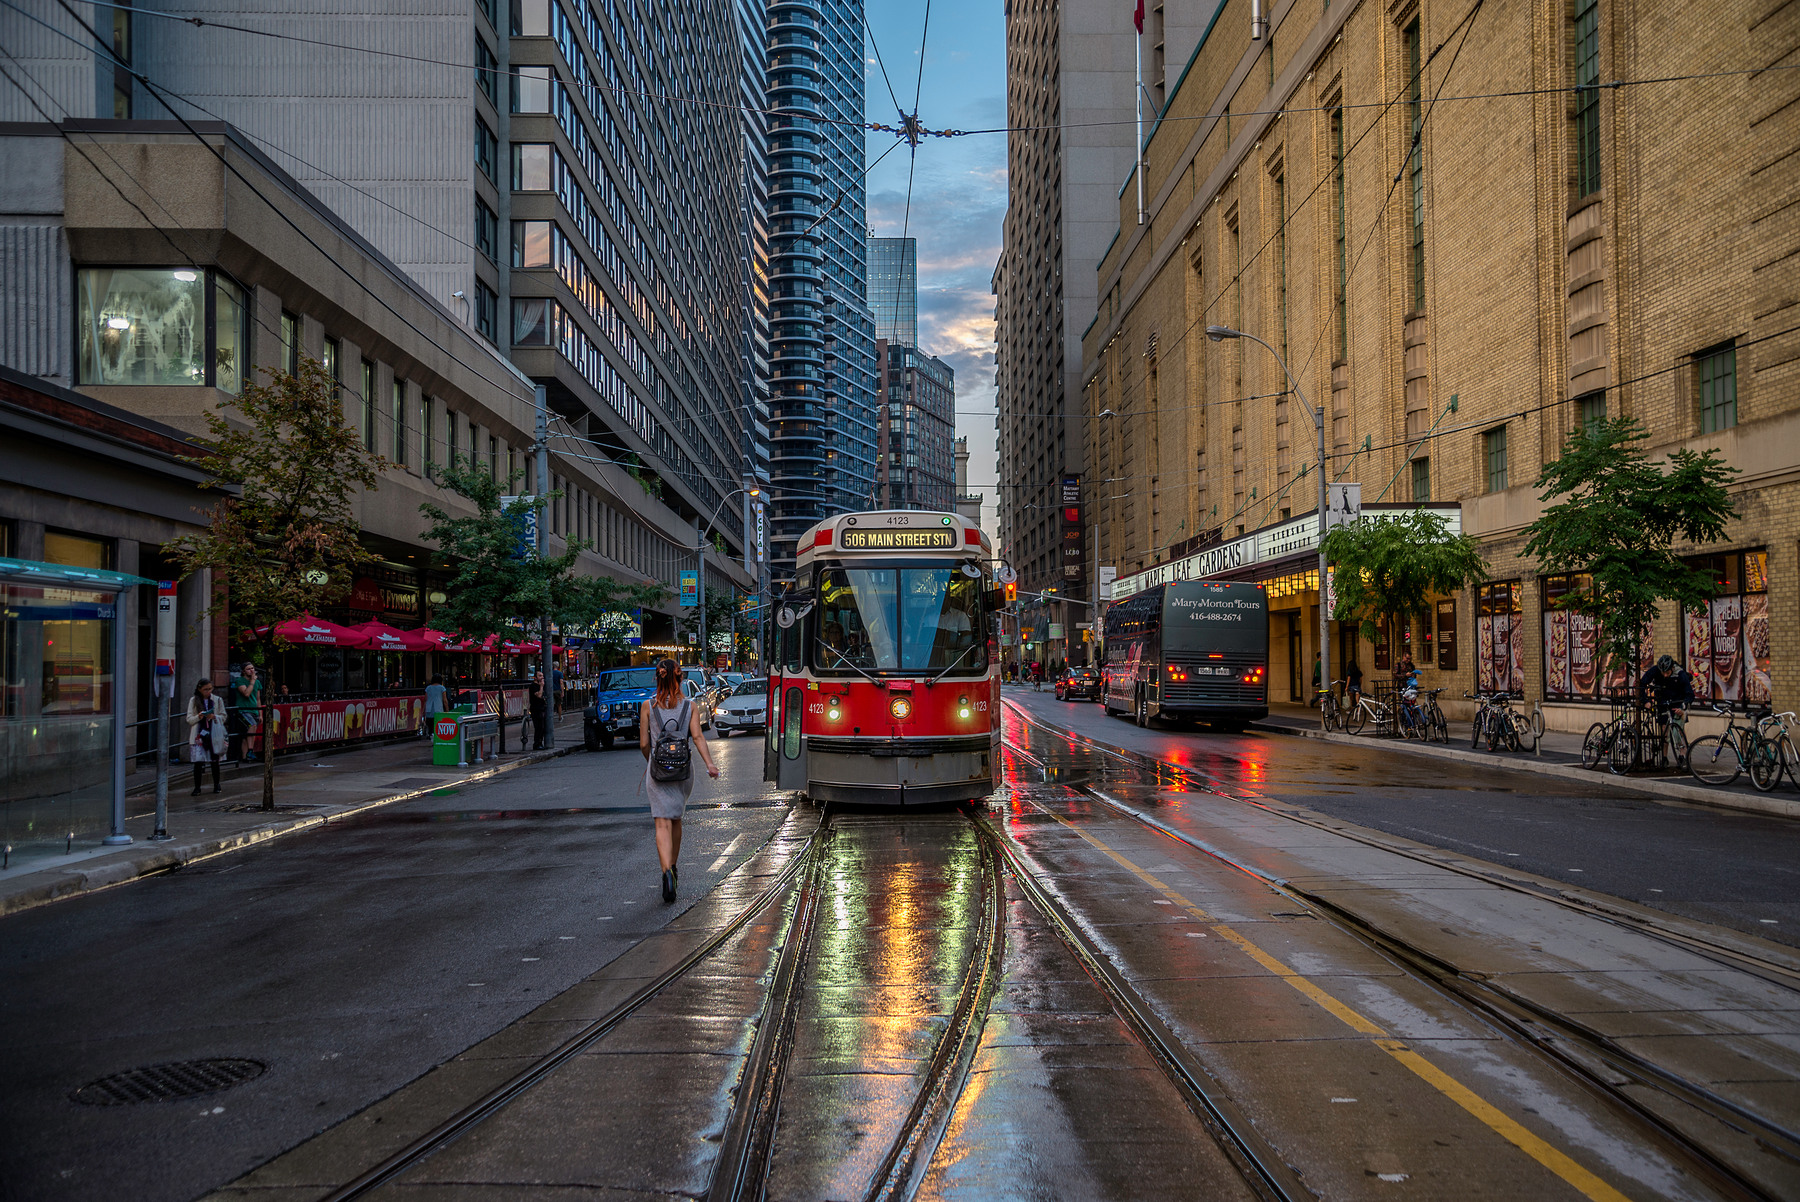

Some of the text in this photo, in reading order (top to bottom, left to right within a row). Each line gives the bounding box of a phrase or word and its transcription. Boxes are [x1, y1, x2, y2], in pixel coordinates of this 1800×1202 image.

[887, 517, 909, 525] 4123
[845, 533, 952, 547] 506 MAIN STREET STN
[1172, 558, 1192, 581] LEAF
[1199, 543, 1241, 576] GARDENS
[1172, 598, 1260, 609] Mary Morton Tours
[1190, 612, 1242, 622] 416-488-2674
[1714, 604, 1740, 620] SPREAD
[1715, 620, 1727, 636] THE
[1572, 631, 1583, 648] THE
[1715, 637, 1736, 652] WORD
[1572, 648, 1590, 664] WORD
[809, 704, 824, 714] 4123
[973, 701, 987, 712] 4123
[305, 712, 344, 742] CANADIAN
[365, 707, 397, 734] CANADIAN
[438, 723, 456, 735] NOW
